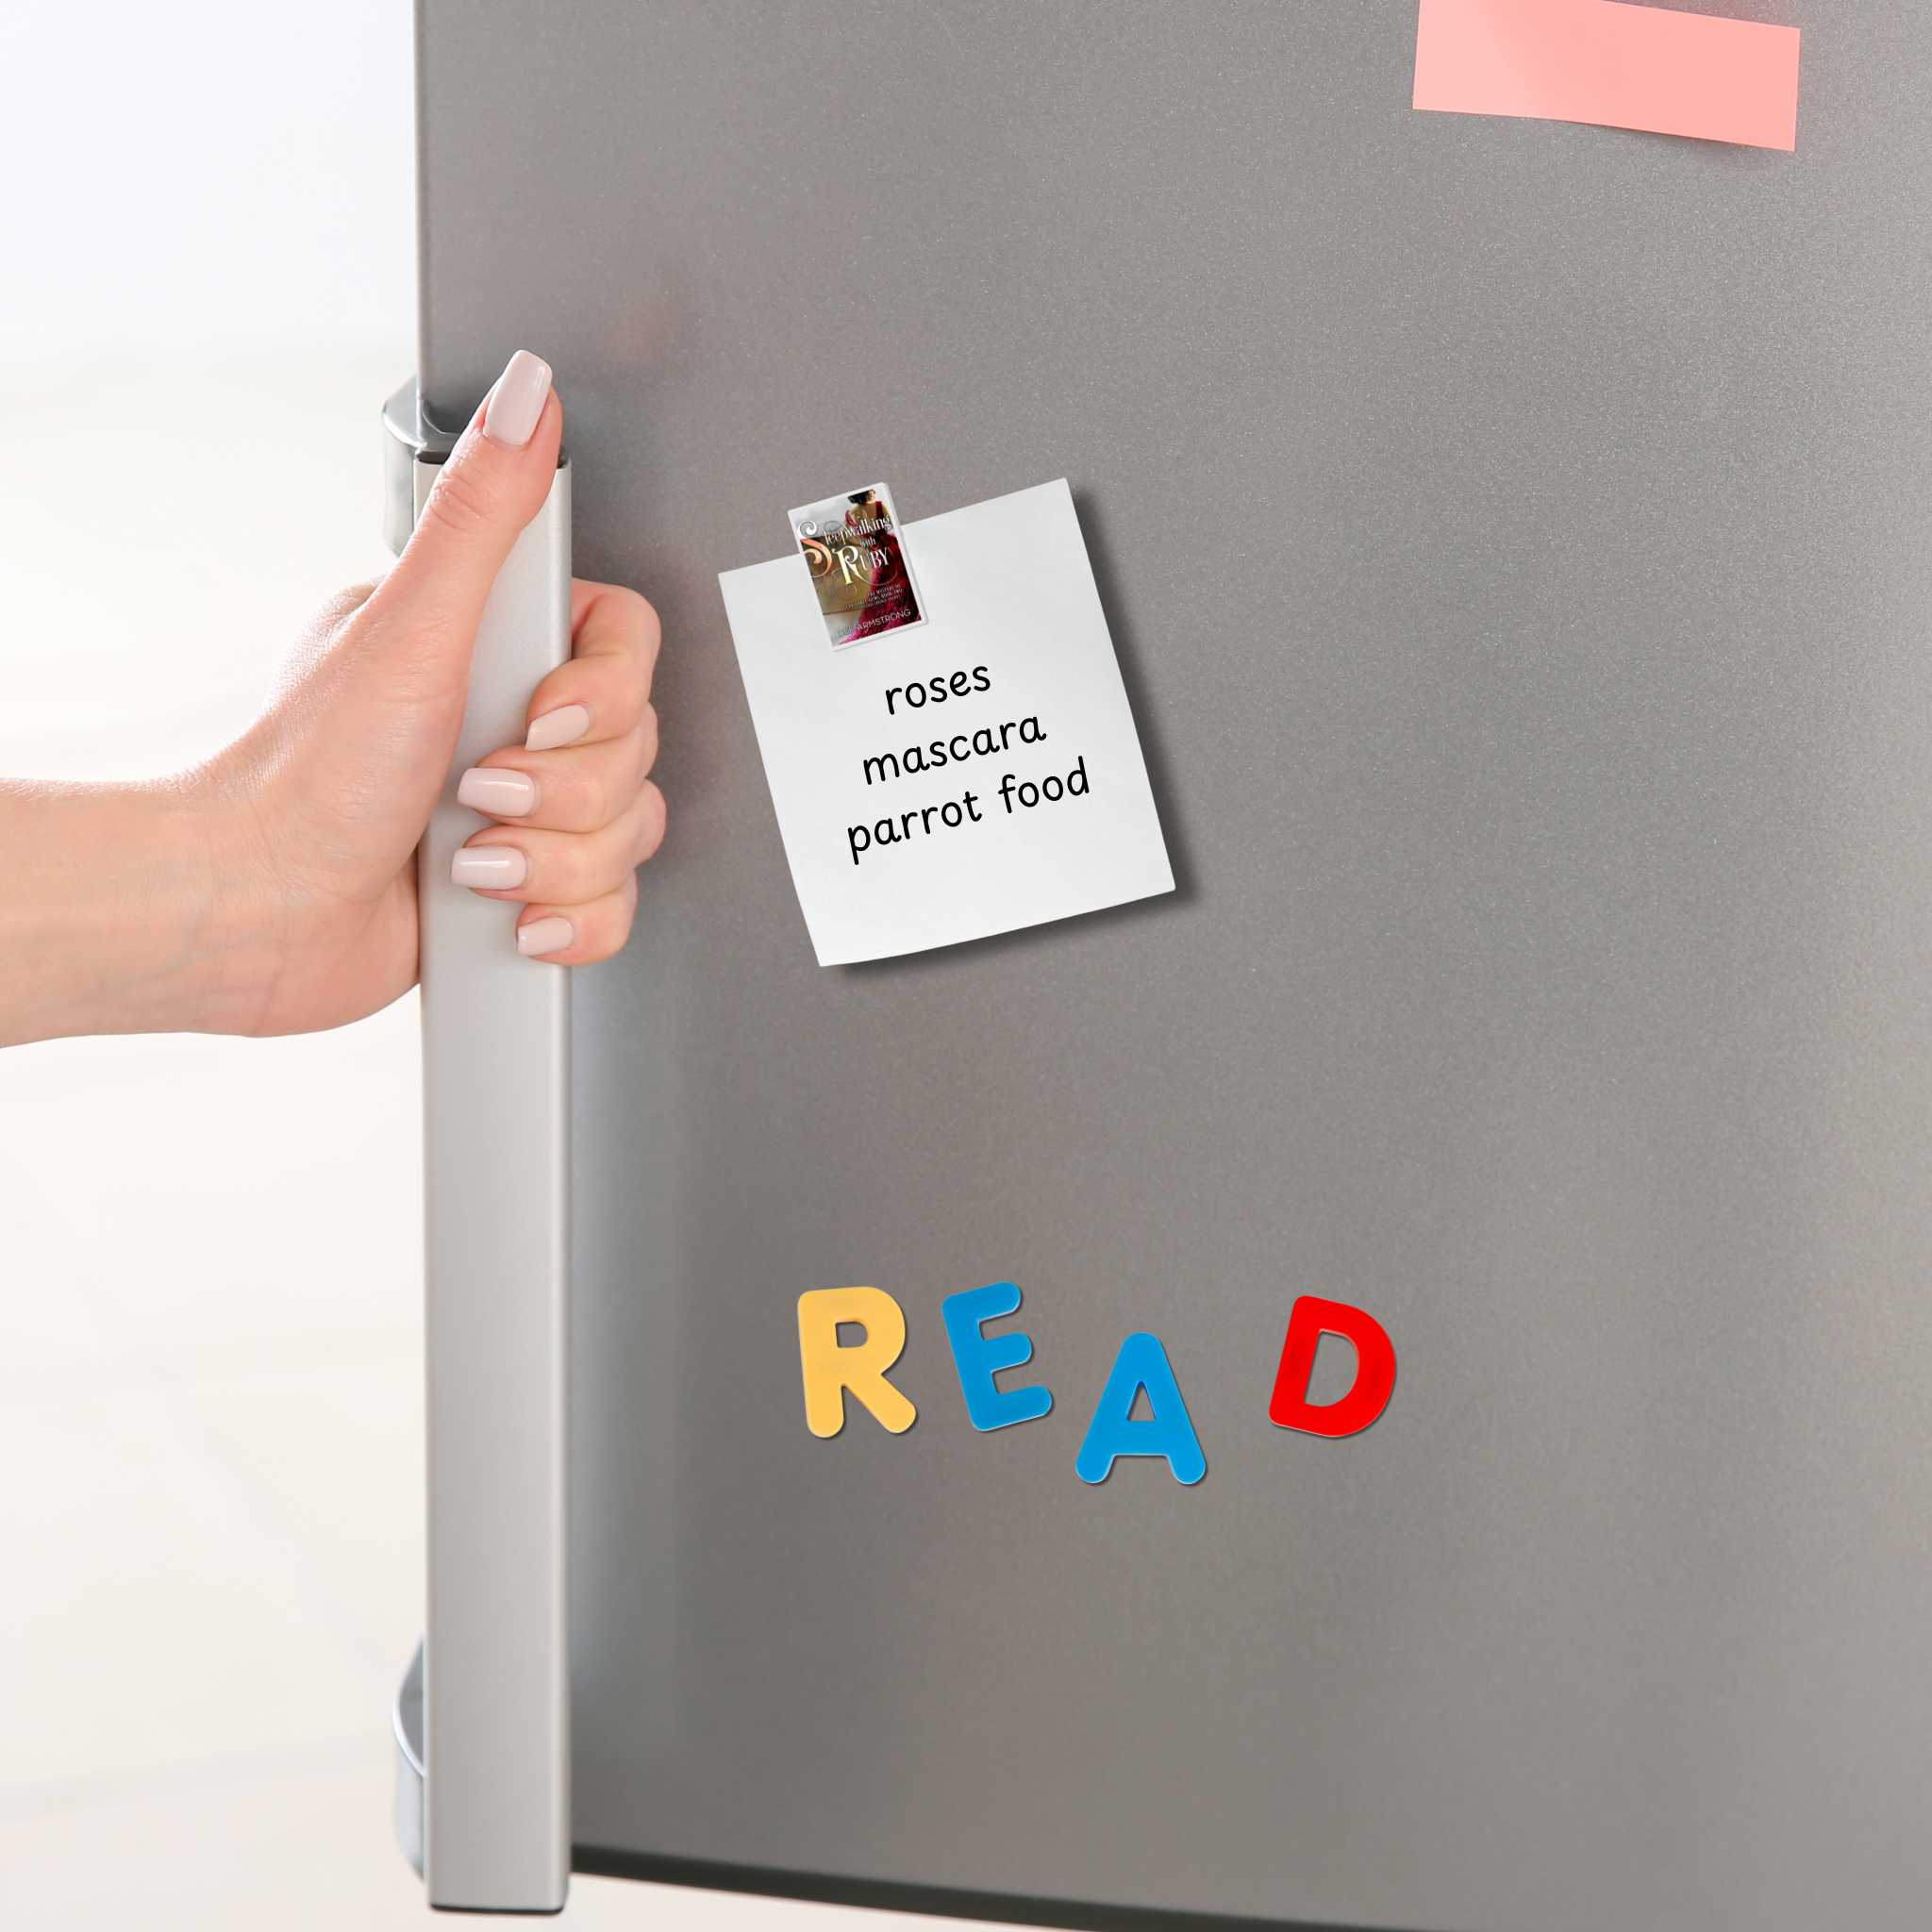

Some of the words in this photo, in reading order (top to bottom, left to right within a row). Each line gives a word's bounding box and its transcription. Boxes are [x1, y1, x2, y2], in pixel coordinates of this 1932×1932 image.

[797, 509, 892, 577] Sleepwalking
[831, 545, 892, 589] RUBY
[859, 536, 876, 548] with
[858, 608, 911, 631] ARMSTRONG
[886, 666, 991, 715] roses
[863, 717, 1046, 785] mascara
[848, 791, 982, 865] parrot
[998, 756, 1089, 813] food
[797, 1281, 1396, 1485] READ
